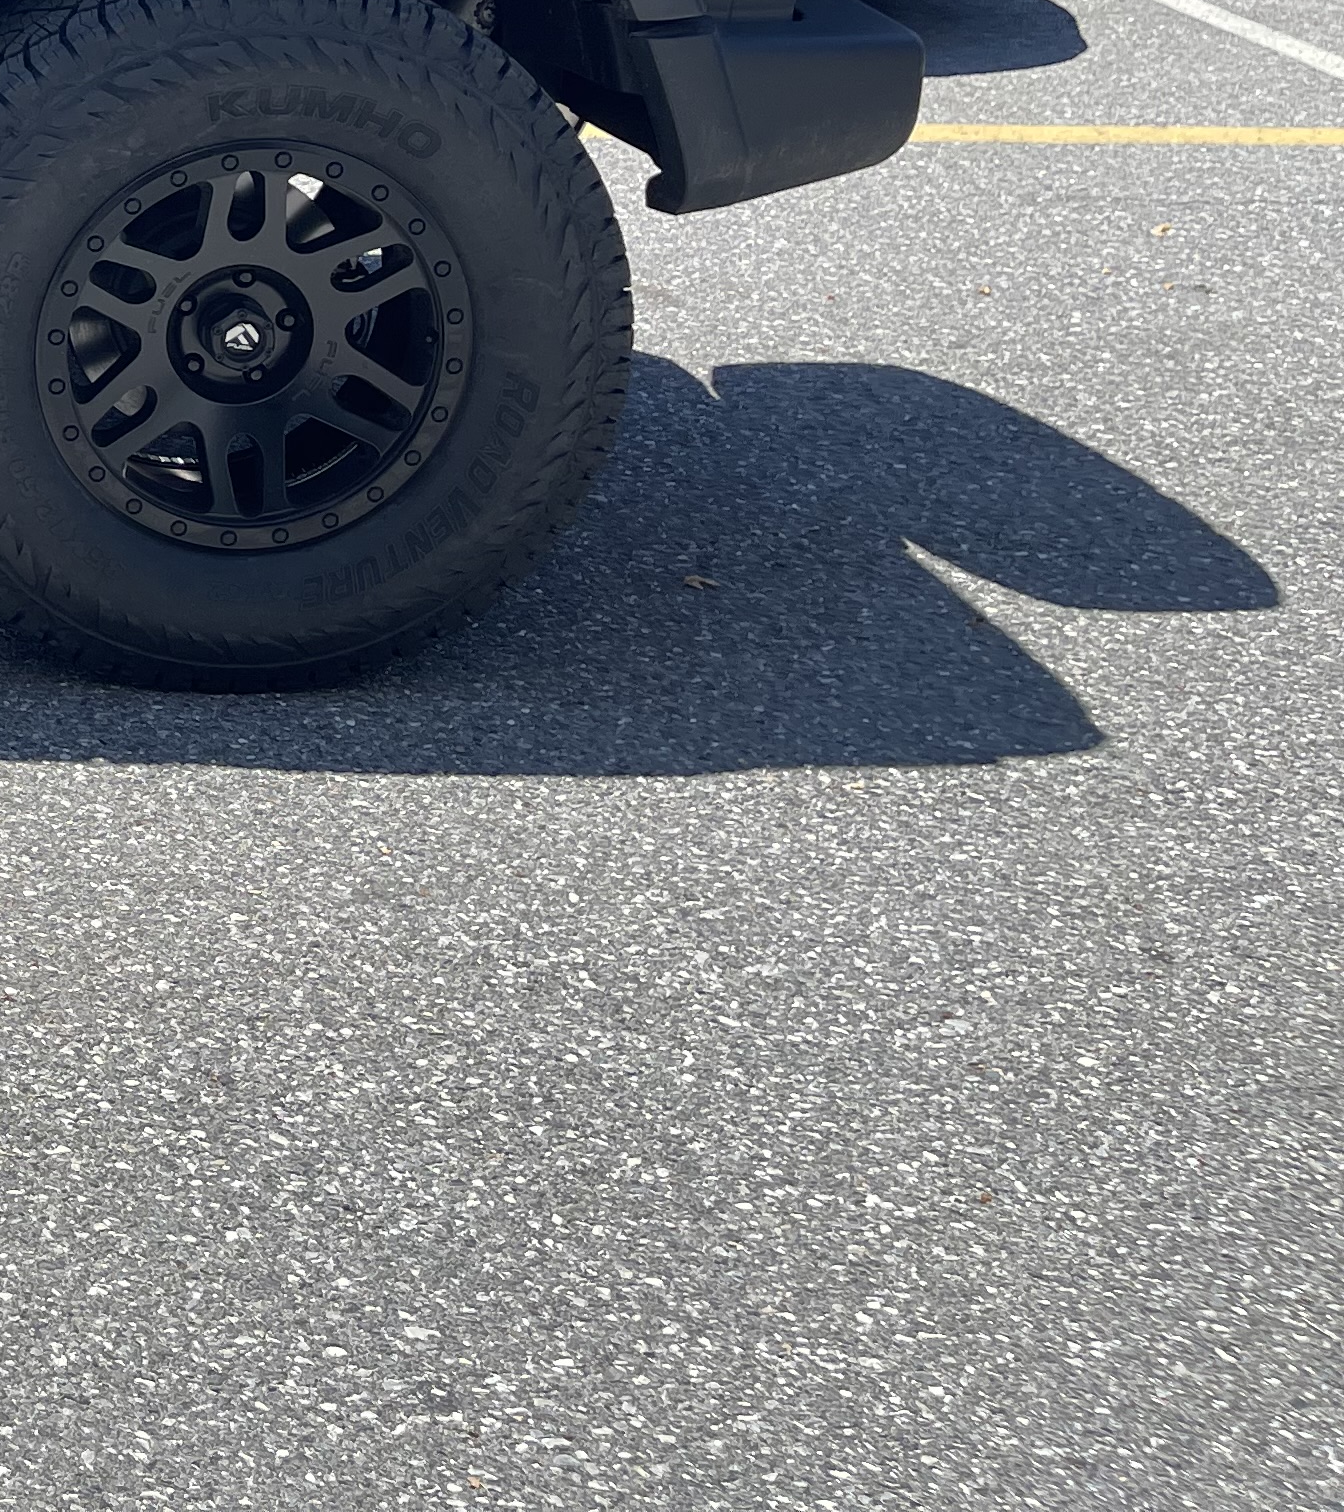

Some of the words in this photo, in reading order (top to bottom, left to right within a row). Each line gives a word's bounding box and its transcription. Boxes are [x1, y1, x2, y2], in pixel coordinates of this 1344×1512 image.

[205, 84, 442, 159] KUMHO
[147, 271, 192, 334] FUEL
[466, 370, 541, 494] ROAD
[299, 486, 484, 612] VENTURE
